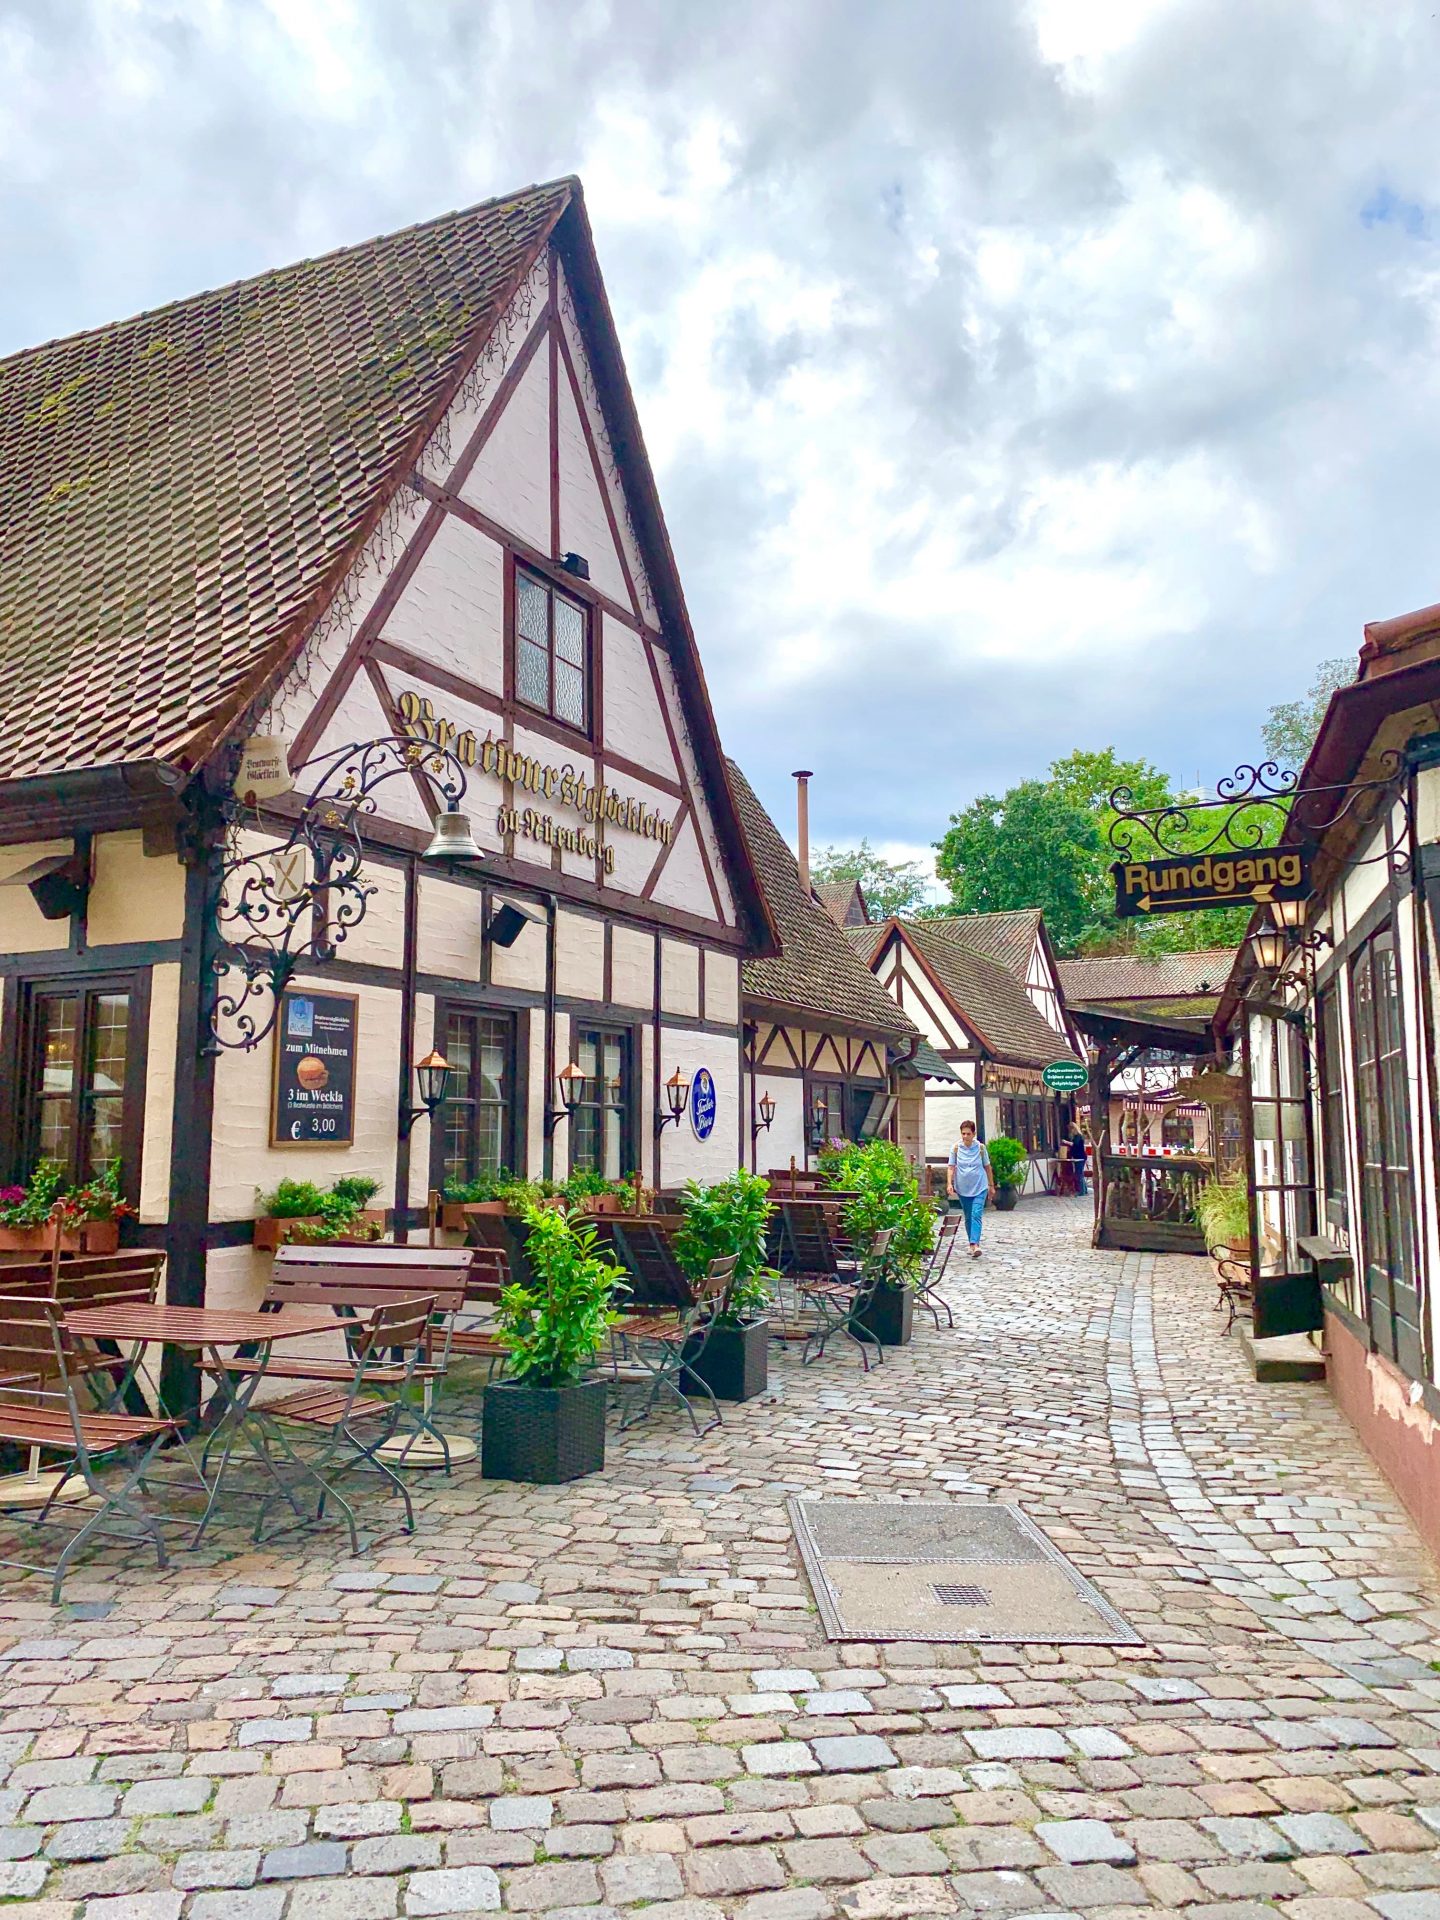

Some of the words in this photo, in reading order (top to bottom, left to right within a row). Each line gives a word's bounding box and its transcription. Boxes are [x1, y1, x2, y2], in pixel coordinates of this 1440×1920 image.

[524, 807, 615, 874] Nürnberg
[1125, 854, 1301, 895] Rundgang
[285, 1044, 303, 1053] zum
[305, 1043, 348, 1056] Mitnehmen
[288, 1088, 294, 1100] 3
[296, 1089, 309, 1101] im
[311, 1090, 343, 1102] Weckla
[291, 1120, 301, 1140] €
[312, 1118, 335, 1133] 3,00
